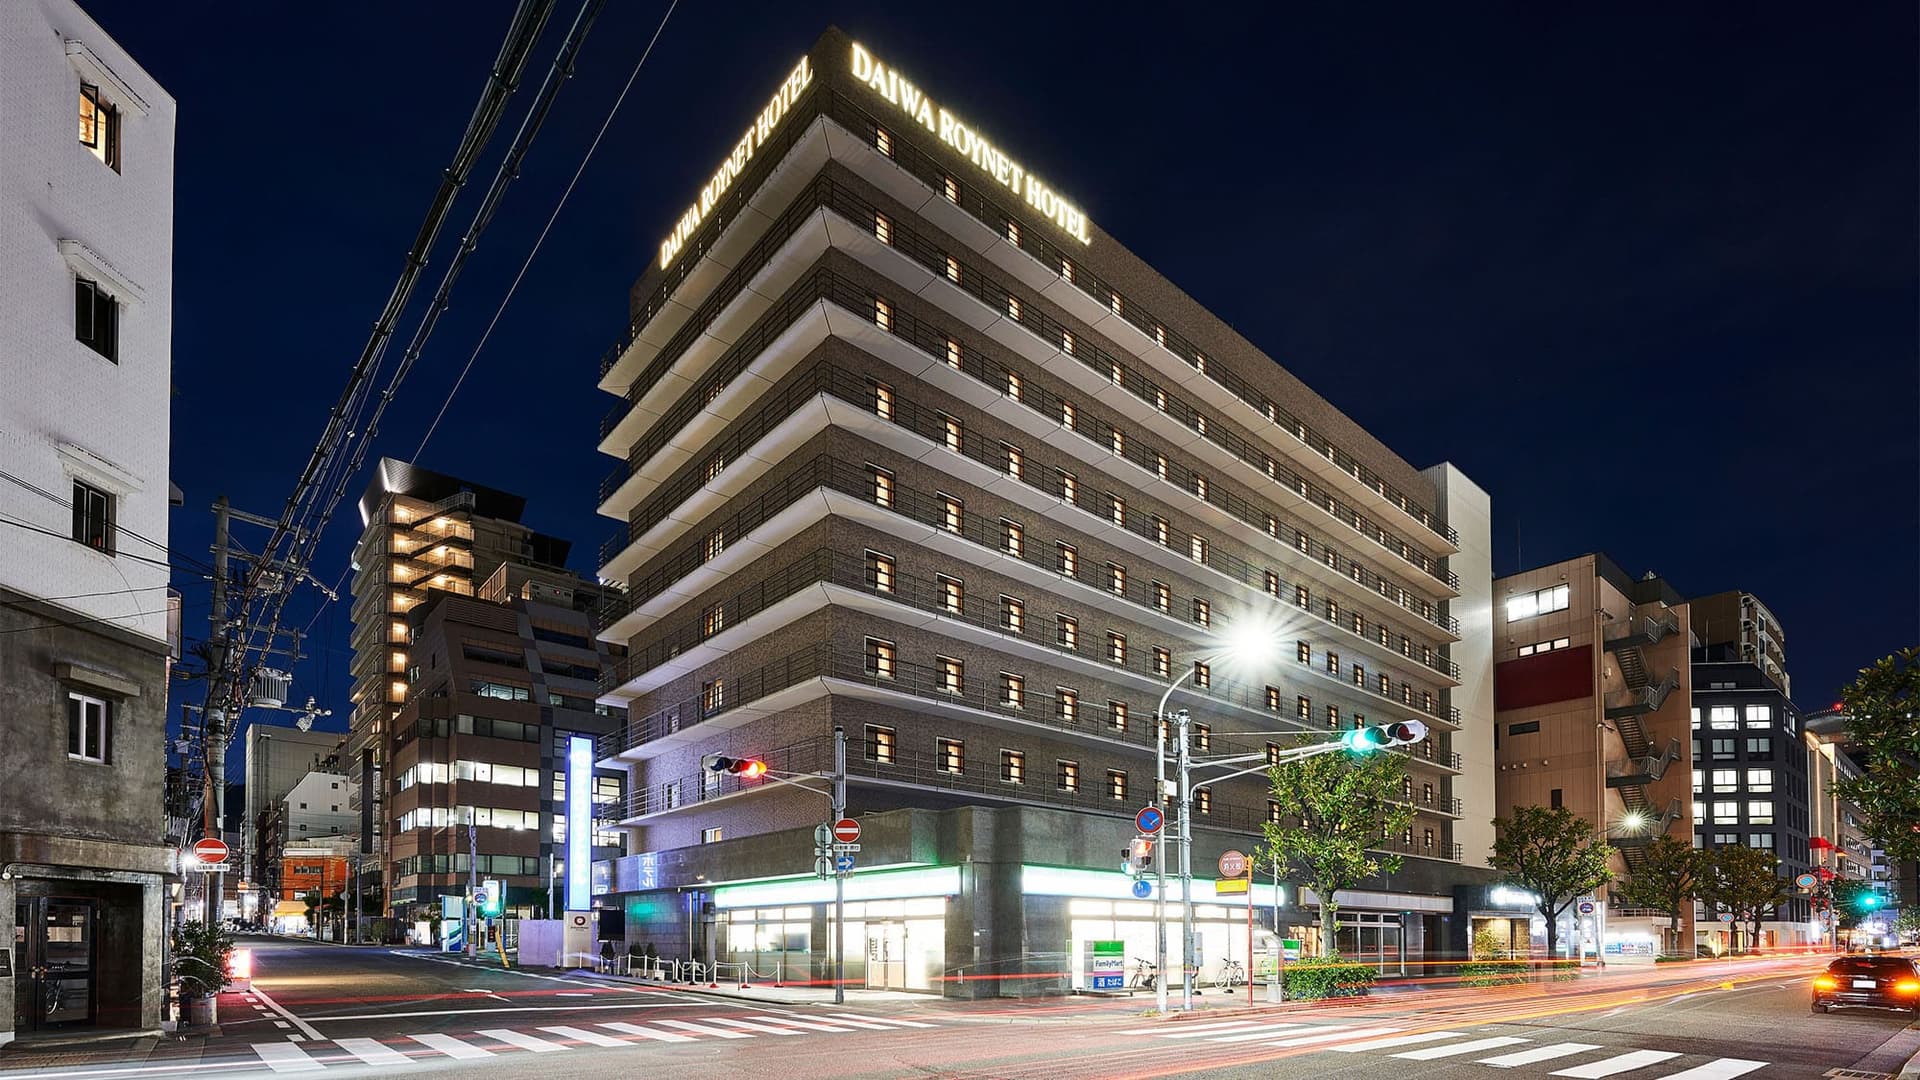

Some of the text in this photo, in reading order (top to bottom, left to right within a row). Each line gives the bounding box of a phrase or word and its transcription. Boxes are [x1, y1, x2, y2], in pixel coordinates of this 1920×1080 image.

[660, 55, 813, 269] DAIWA ROYNET HOTEL
[852, 42, 1091, 246] DAIWA ROYNET HOTEL
[1095, 959, 1123, 969] FamilyMart
